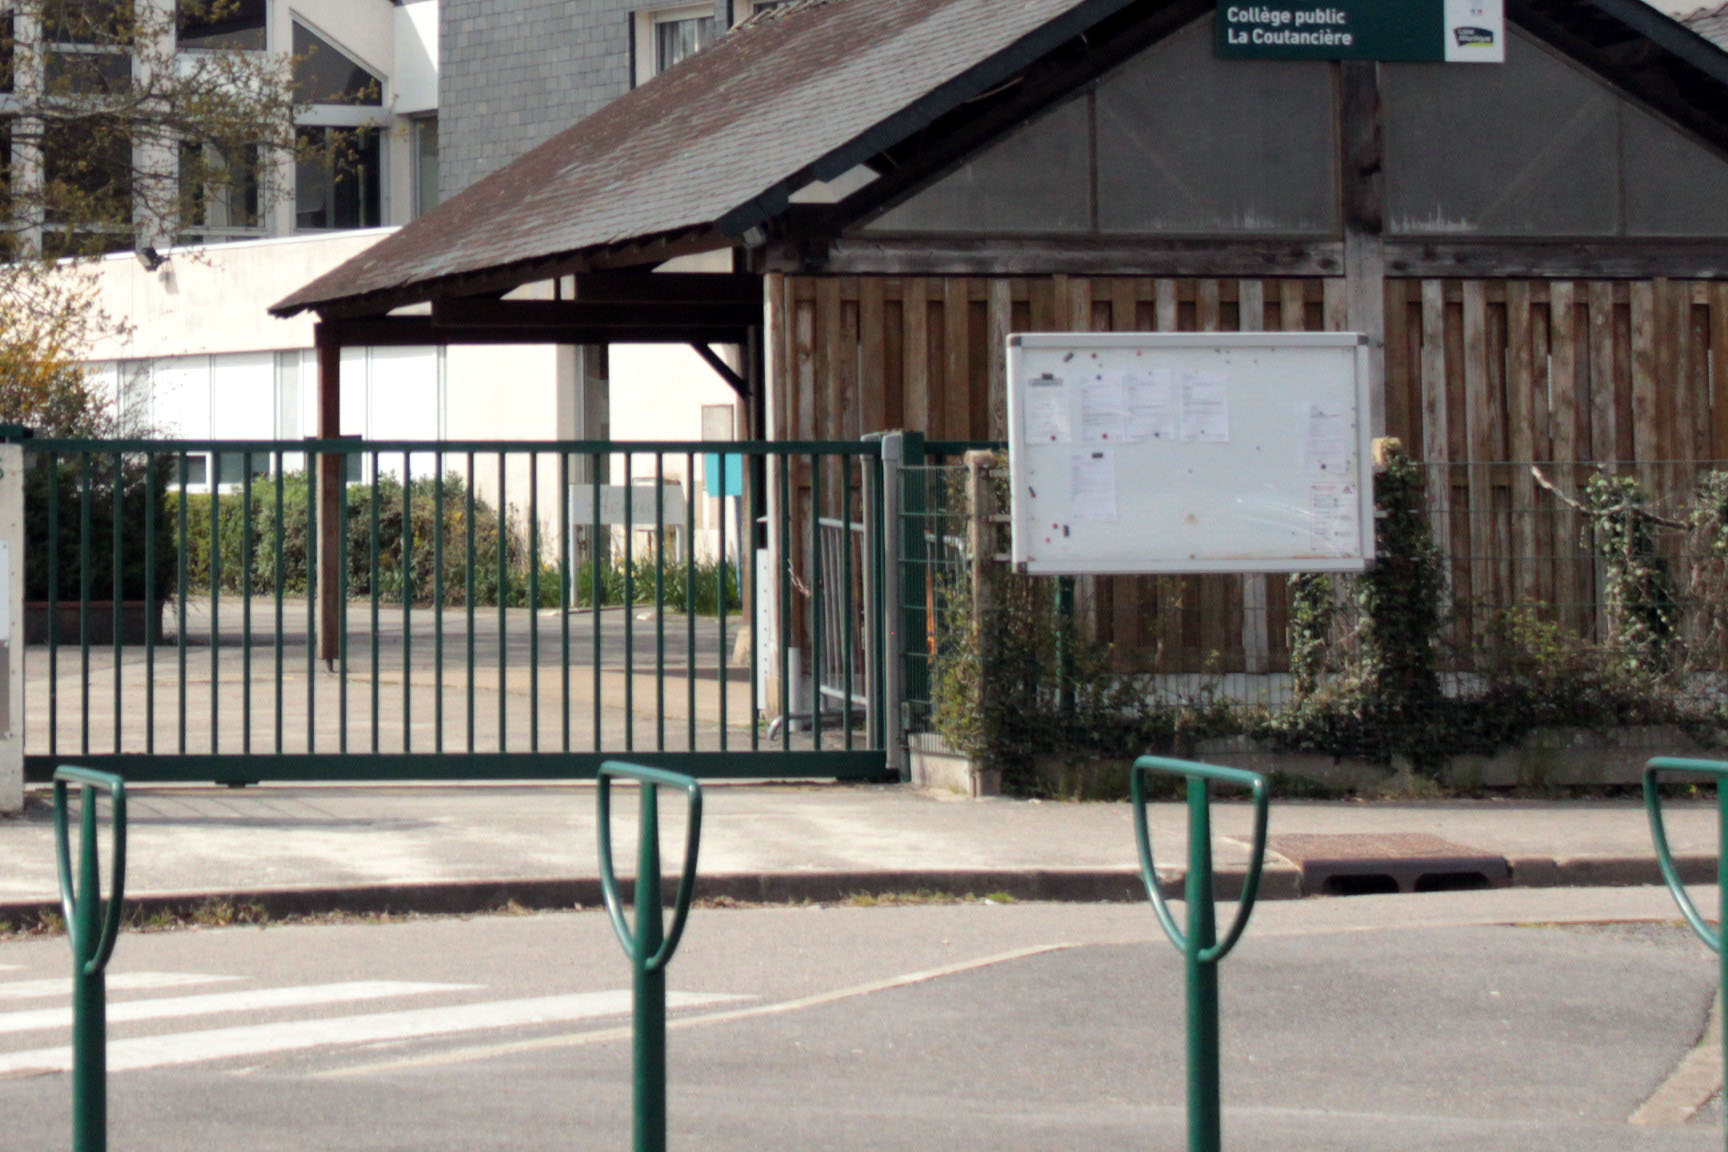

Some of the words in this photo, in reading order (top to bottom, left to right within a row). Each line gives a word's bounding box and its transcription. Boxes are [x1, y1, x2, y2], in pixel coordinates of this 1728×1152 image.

[1227, 6, 1291, 26] Collège
[1295, 8, 1346, 26] public
[1227, 28, 1249, 44] La
[1252, 28, 1353, 46] Coutancière
